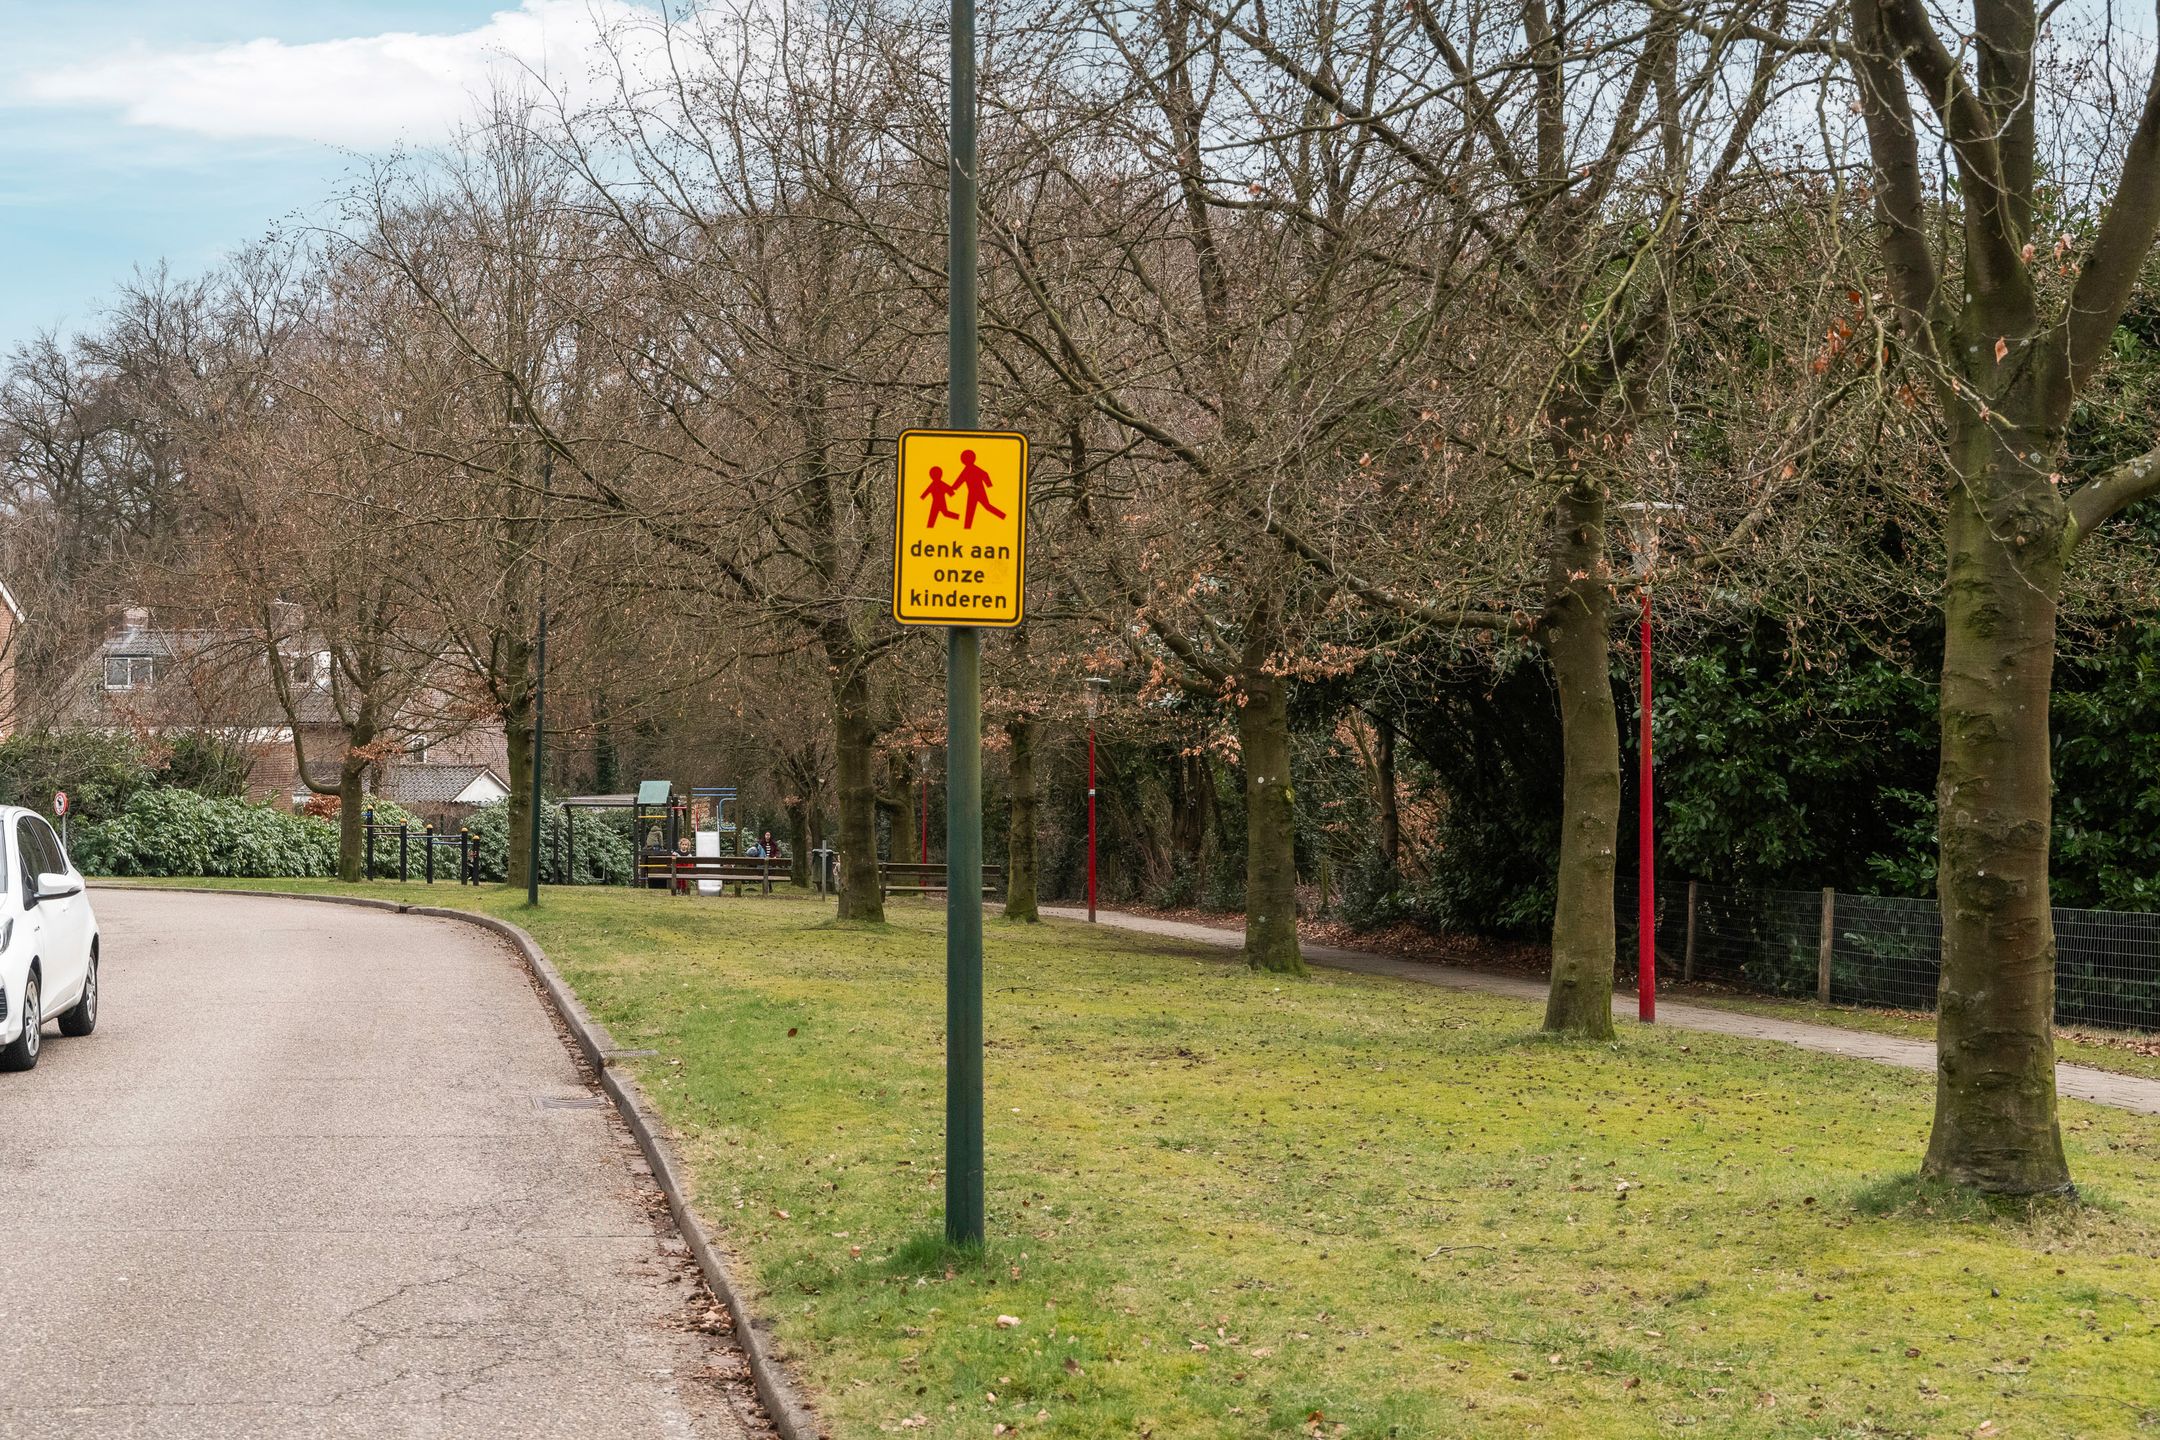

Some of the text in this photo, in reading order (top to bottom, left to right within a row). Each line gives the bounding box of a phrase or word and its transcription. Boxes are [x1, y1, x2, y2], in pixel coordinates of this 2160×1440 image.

[910, 540, 1010, 560] denk aan
[933, 569, 985, 584] onze
[910, 589, 1007, 609] kinderen
